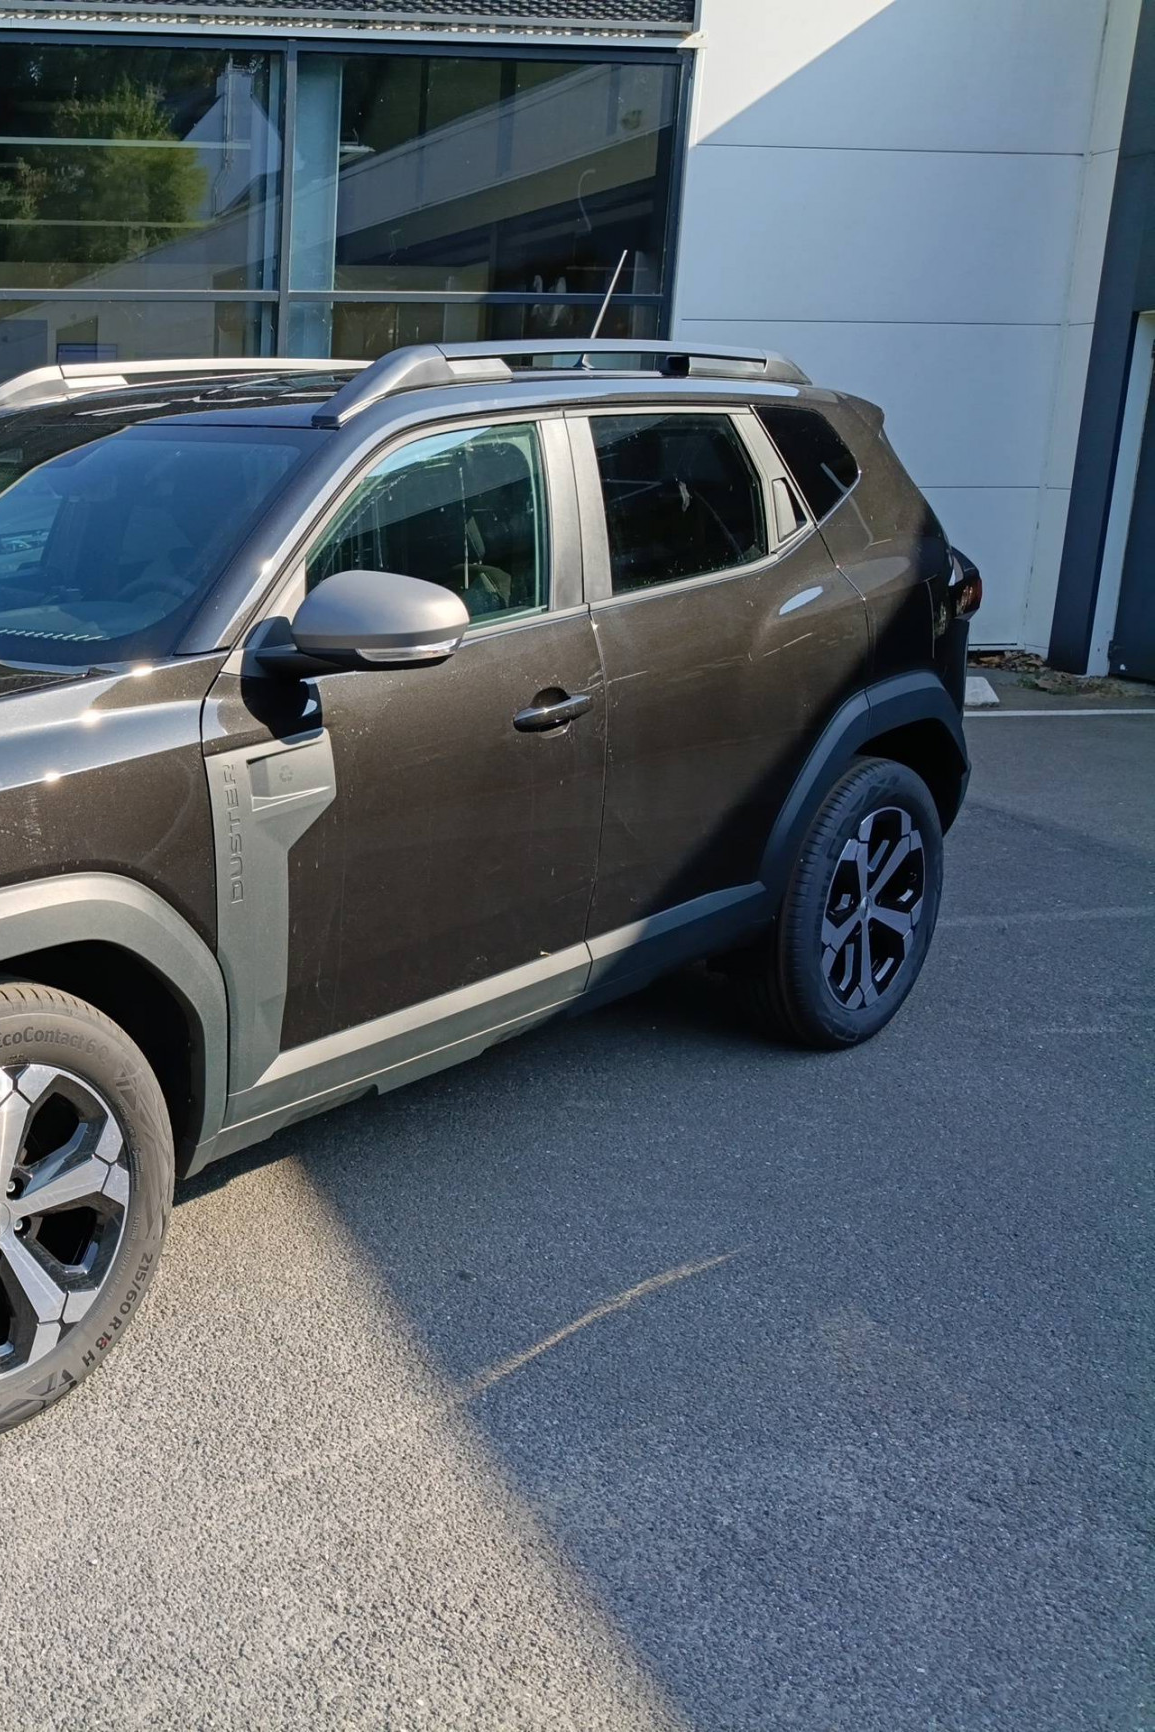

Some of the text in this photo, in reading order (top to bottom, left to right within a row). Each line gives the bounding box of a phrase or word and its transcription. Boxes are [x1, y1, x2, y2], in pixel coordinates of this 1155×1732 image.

[222, 764, 244, 905] DUSTER
[86, 1039, 96, 1054] 6
[119, 1252, 153, 1315] 215/60
[108, 1315, 123, 1331] R
[96, 1331, 113, 1351] 18
[81, 1350, 96, 1367] H
